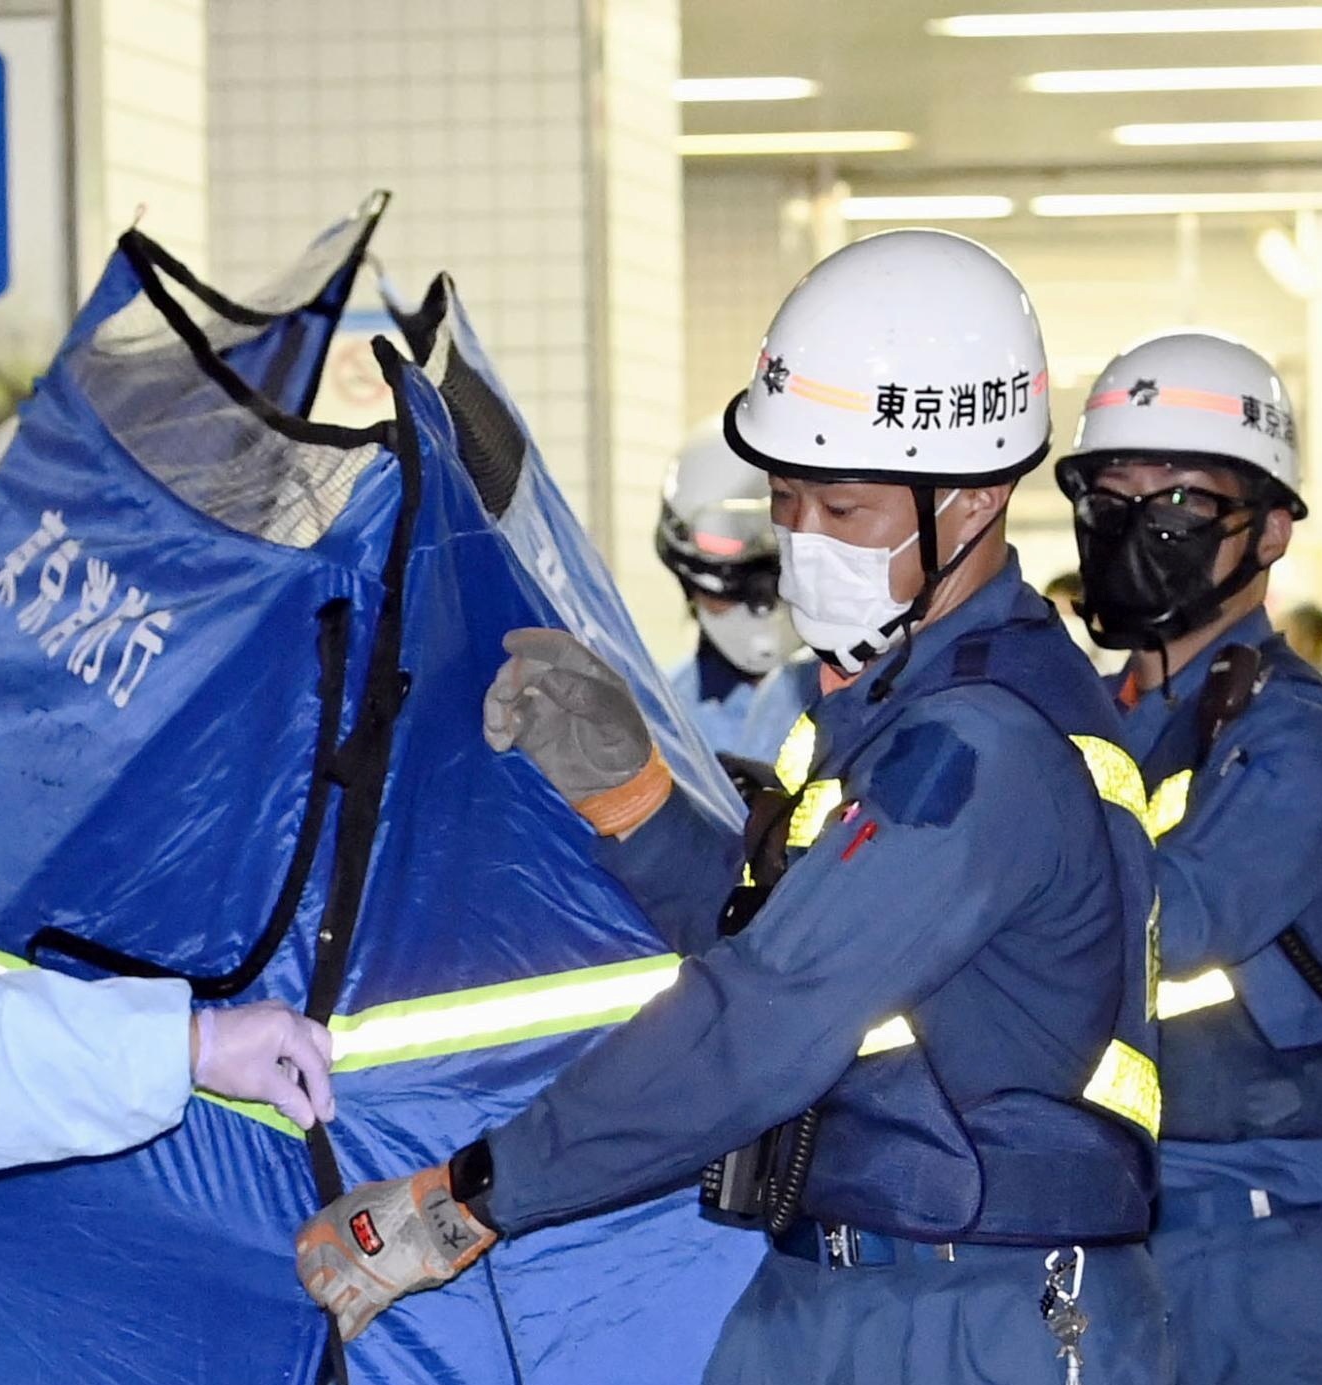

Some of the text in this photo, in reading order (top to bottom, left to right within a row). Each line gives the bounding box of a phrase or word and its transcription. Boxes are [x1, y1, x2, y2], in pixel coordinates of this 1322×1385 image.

[872, 370, 1031, 431] 東京消防庁
